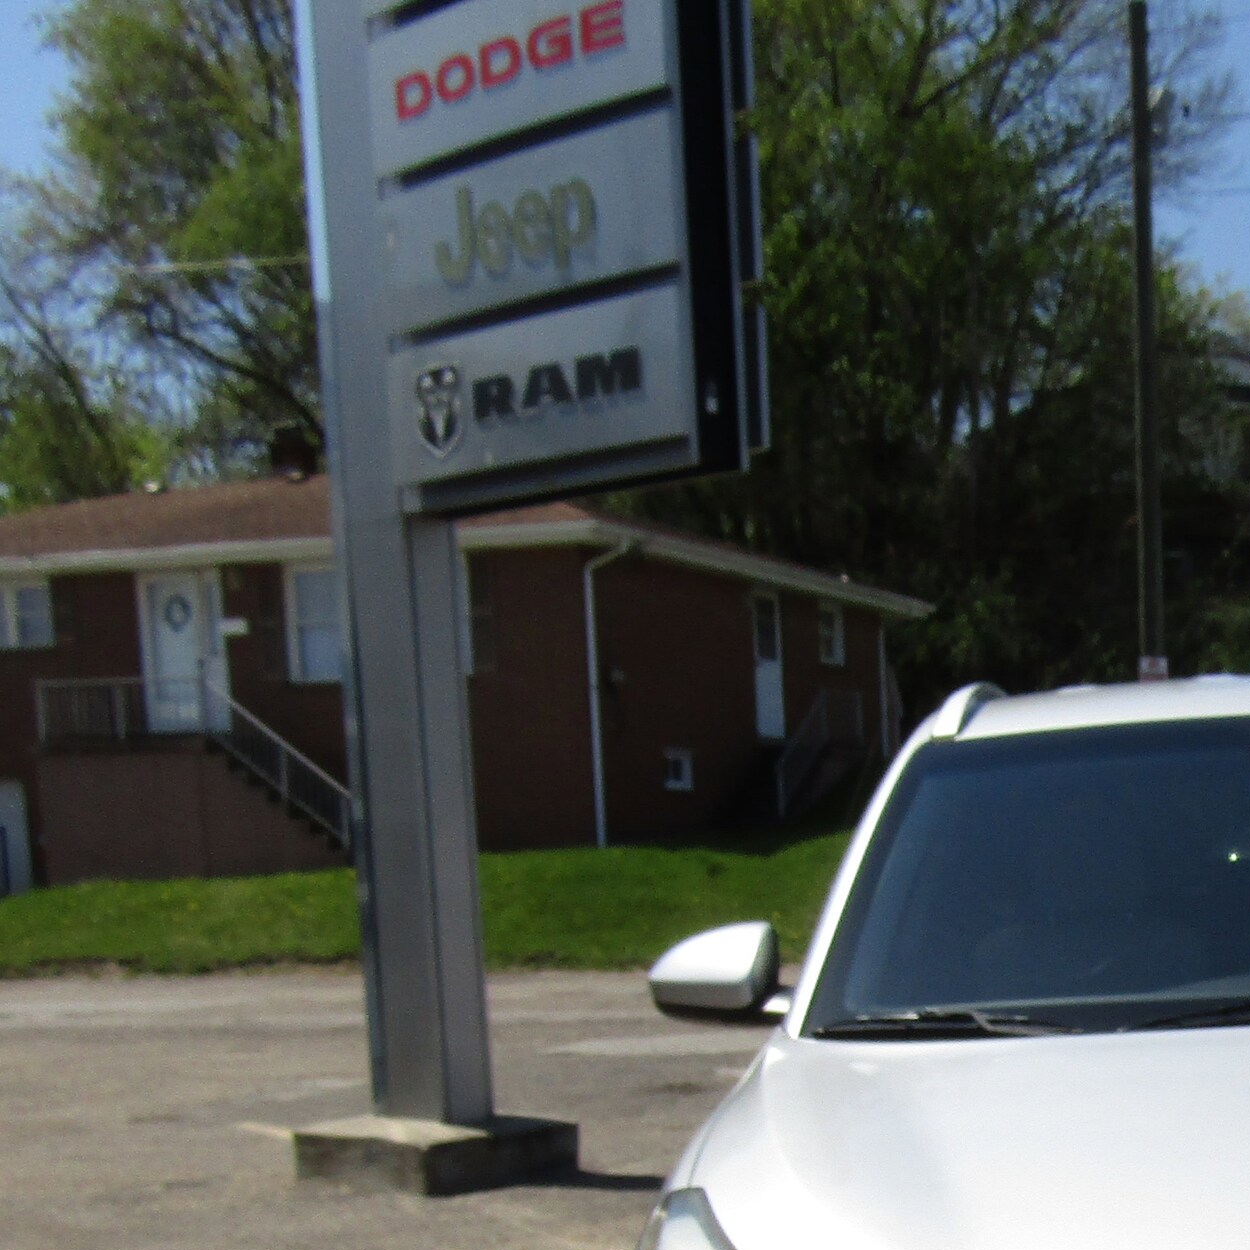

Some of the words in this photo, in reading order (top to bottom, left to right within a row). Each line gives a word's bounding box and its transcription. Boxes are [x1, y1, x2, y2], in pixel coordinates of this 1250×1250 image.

[395, 0, 625, 120] DODGE
[434, 177, 597, 282] Jeep
[472, 346, 641, 421] RAM
